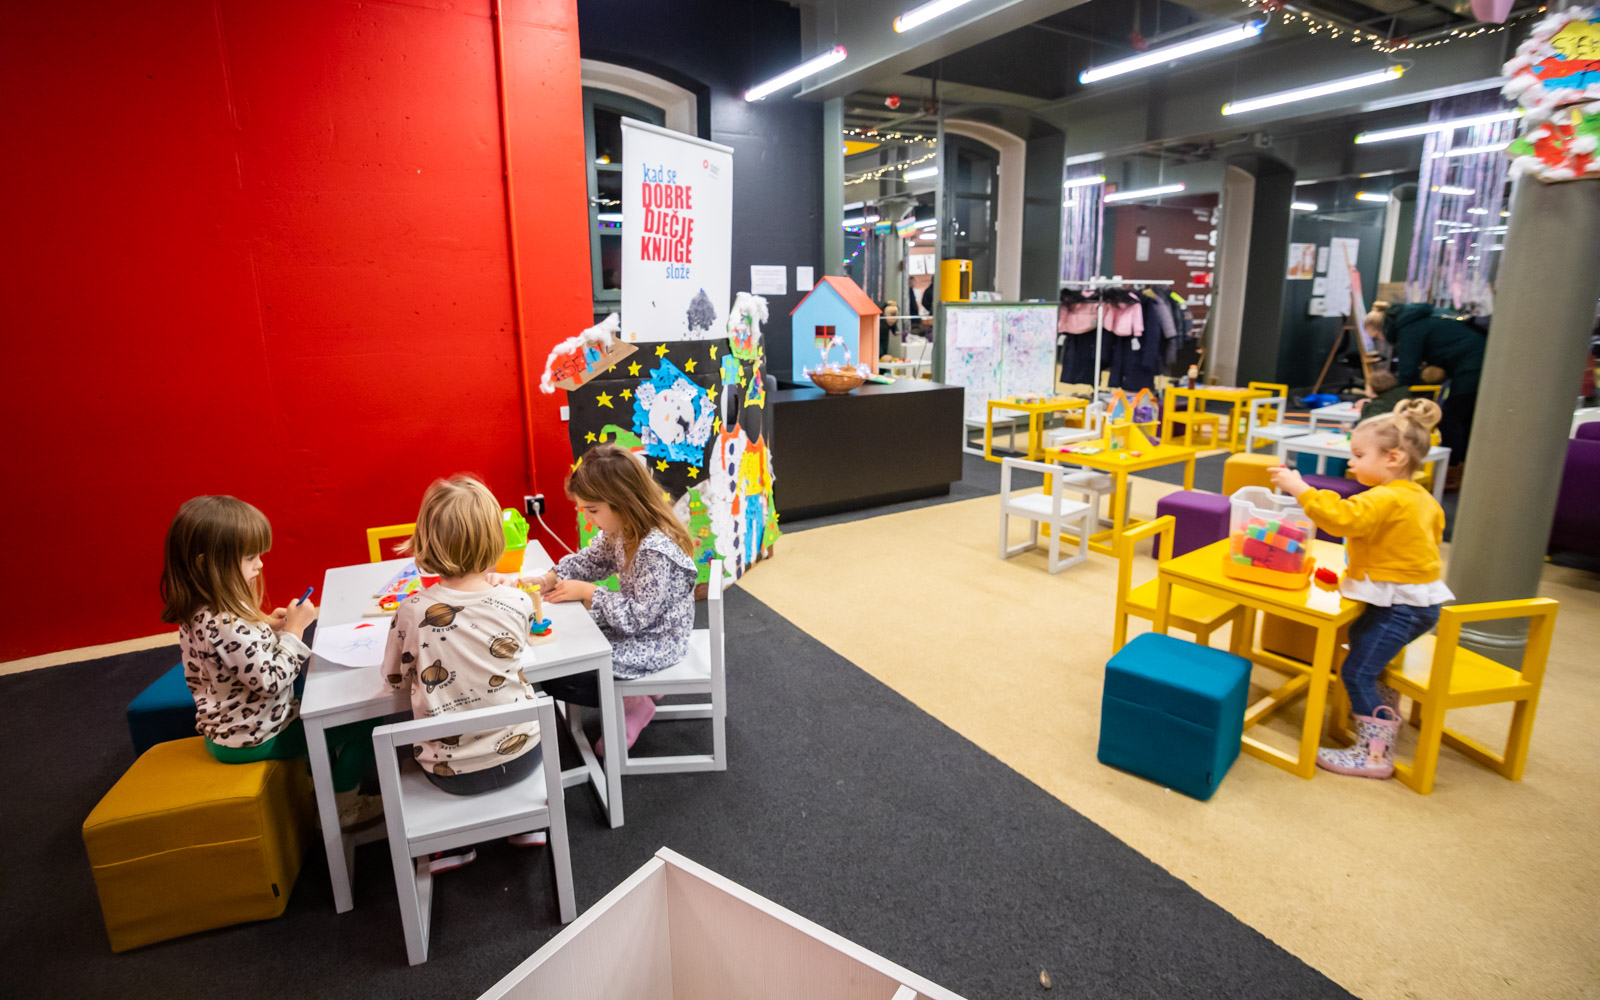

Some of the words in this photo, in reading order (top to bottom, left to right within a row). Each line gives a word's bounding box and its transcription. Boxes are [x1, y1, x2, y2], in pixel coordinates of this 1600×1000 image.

[642, 163, 664, 184] kad
[666, 169, 677, 185] se
[642, 182, 693, 209] DOBRE
[644, 208, 694, 241] DJEČJE
[641, 236, 692, 264] KNJIGE
[666, 263, 690, 280] slože
